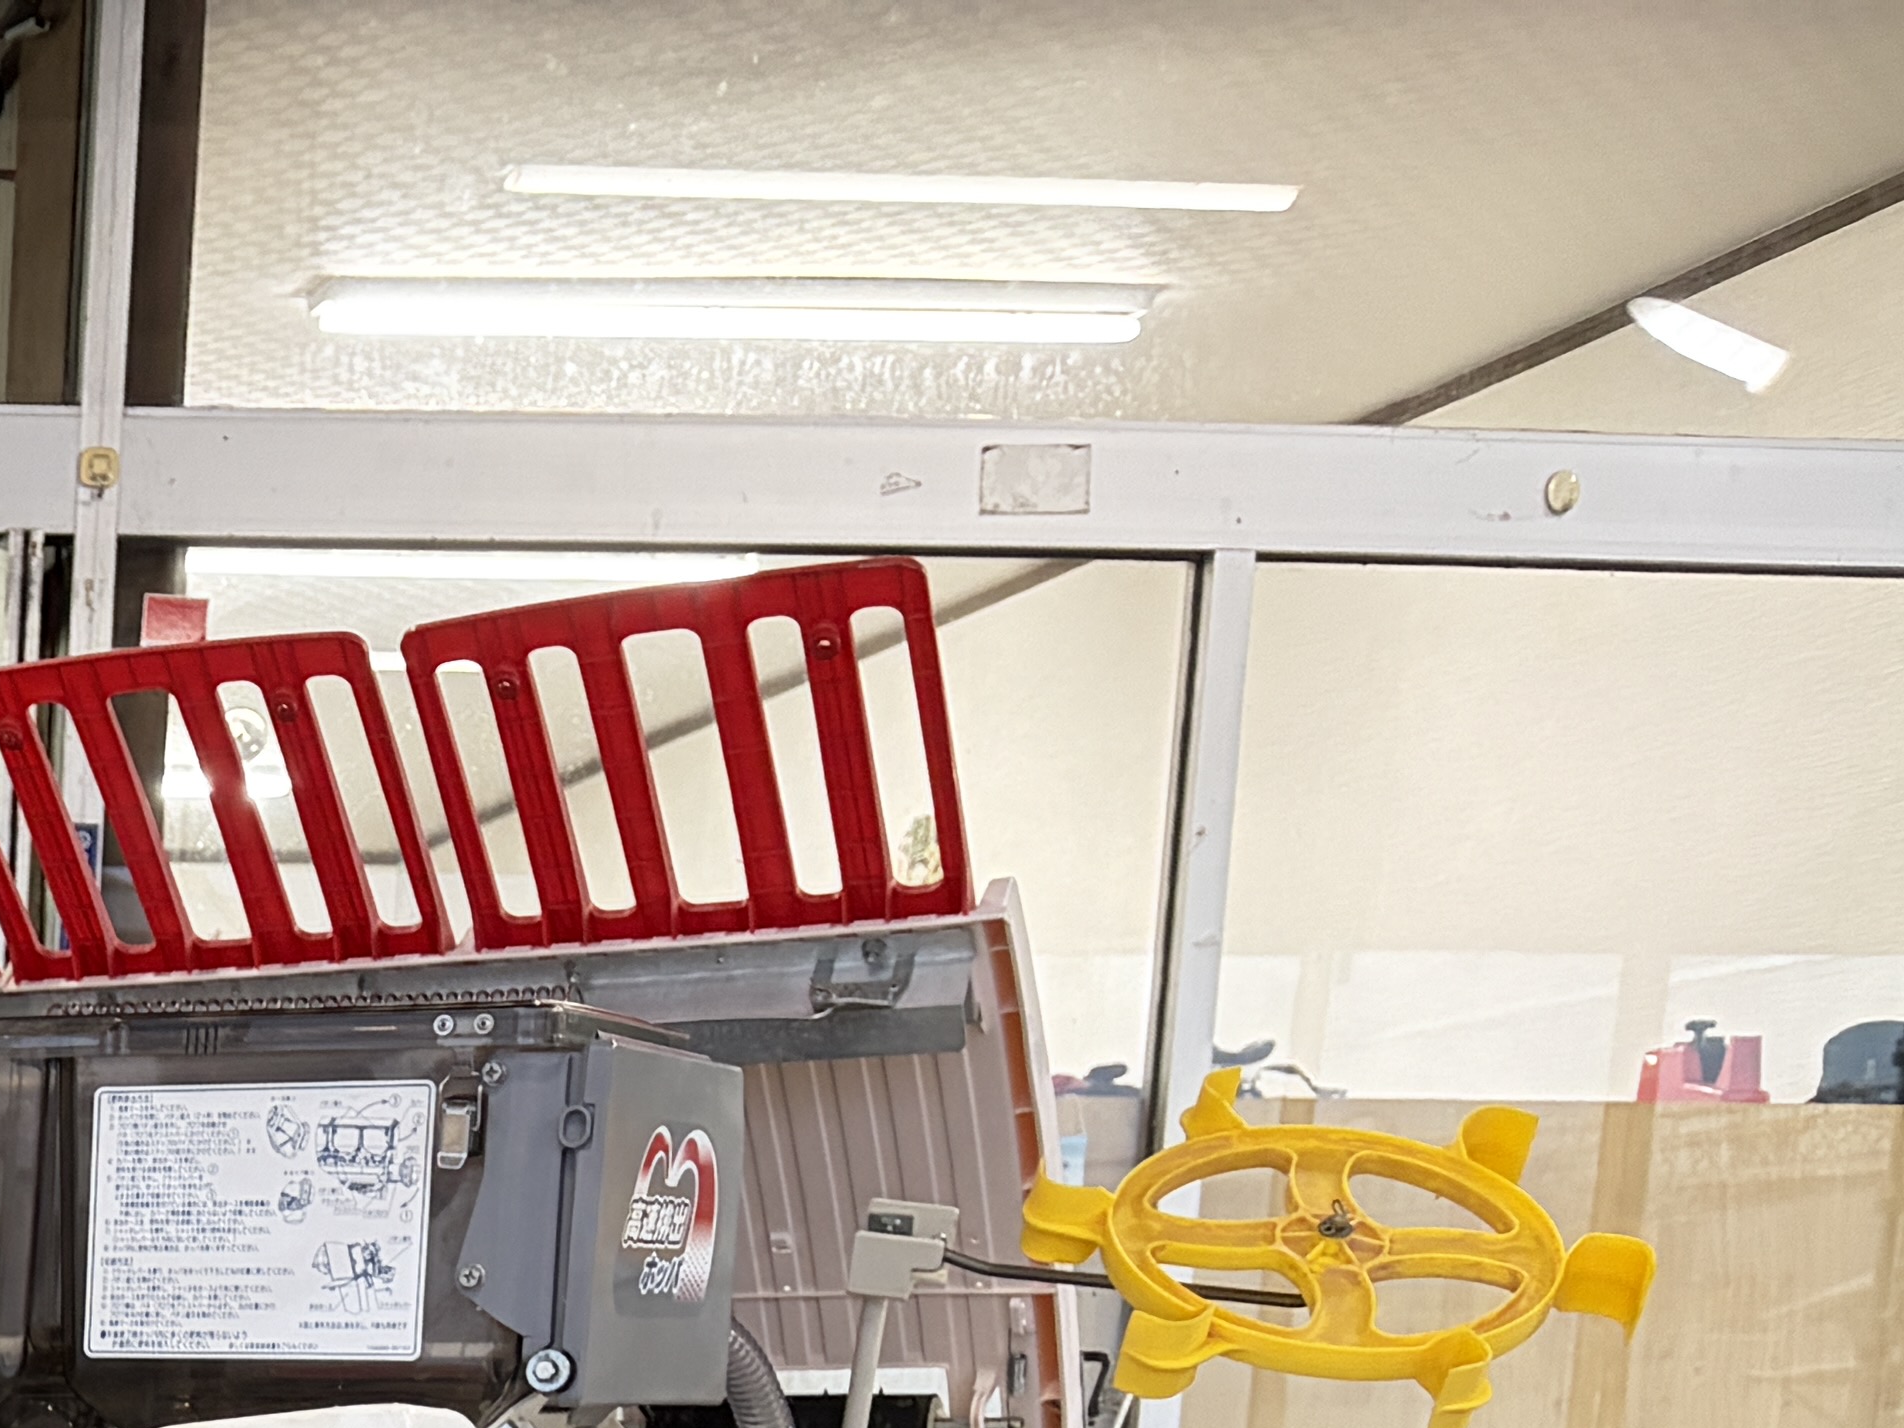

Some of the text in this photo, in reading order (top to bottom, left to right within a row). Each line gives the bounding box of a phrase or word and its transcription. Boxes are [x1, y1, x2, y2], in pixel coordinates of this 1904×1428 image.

[623, 1196, 690, 1247] 高速排出
[639, 1253, 682, 1294] ホッパ
